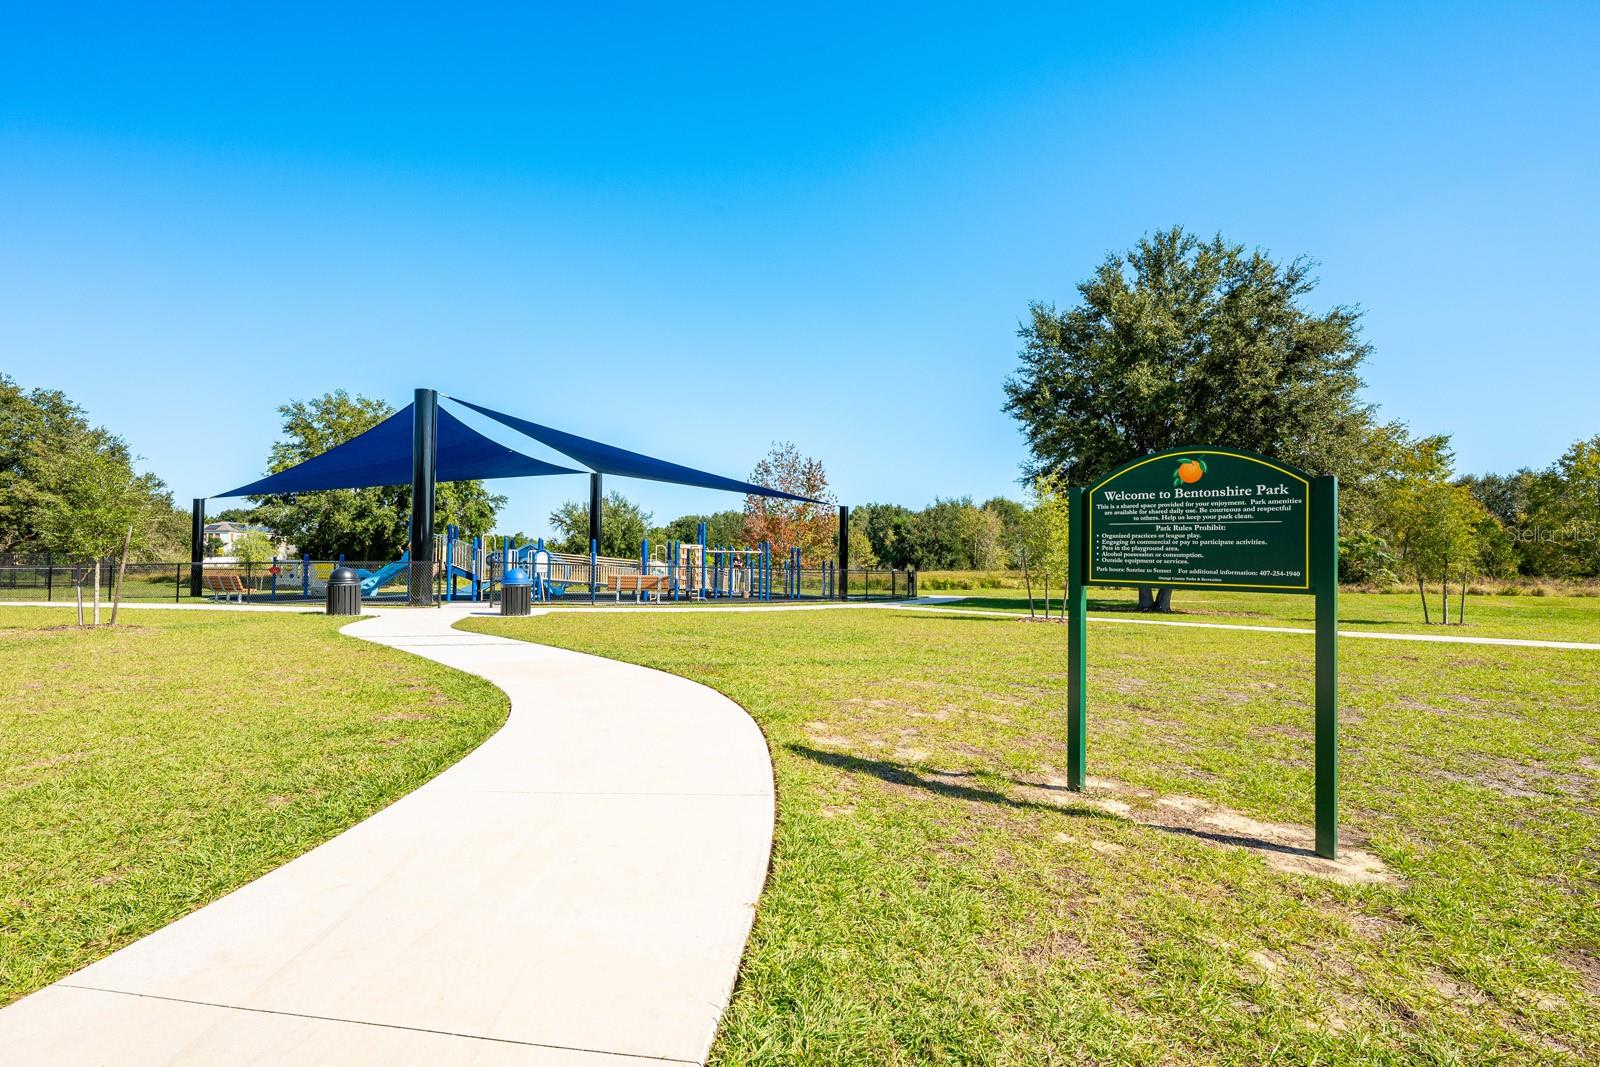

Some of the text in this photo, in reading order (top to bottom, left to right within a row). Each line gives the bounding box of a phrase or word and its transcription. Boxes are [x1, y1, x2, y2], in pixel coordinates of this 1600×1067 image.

[1104, 484, 1289, 500] Welcome to Bentonshire Park
[1257, 505, 1291, 513] respectful
[1199, 539, 1234, 547] participate
